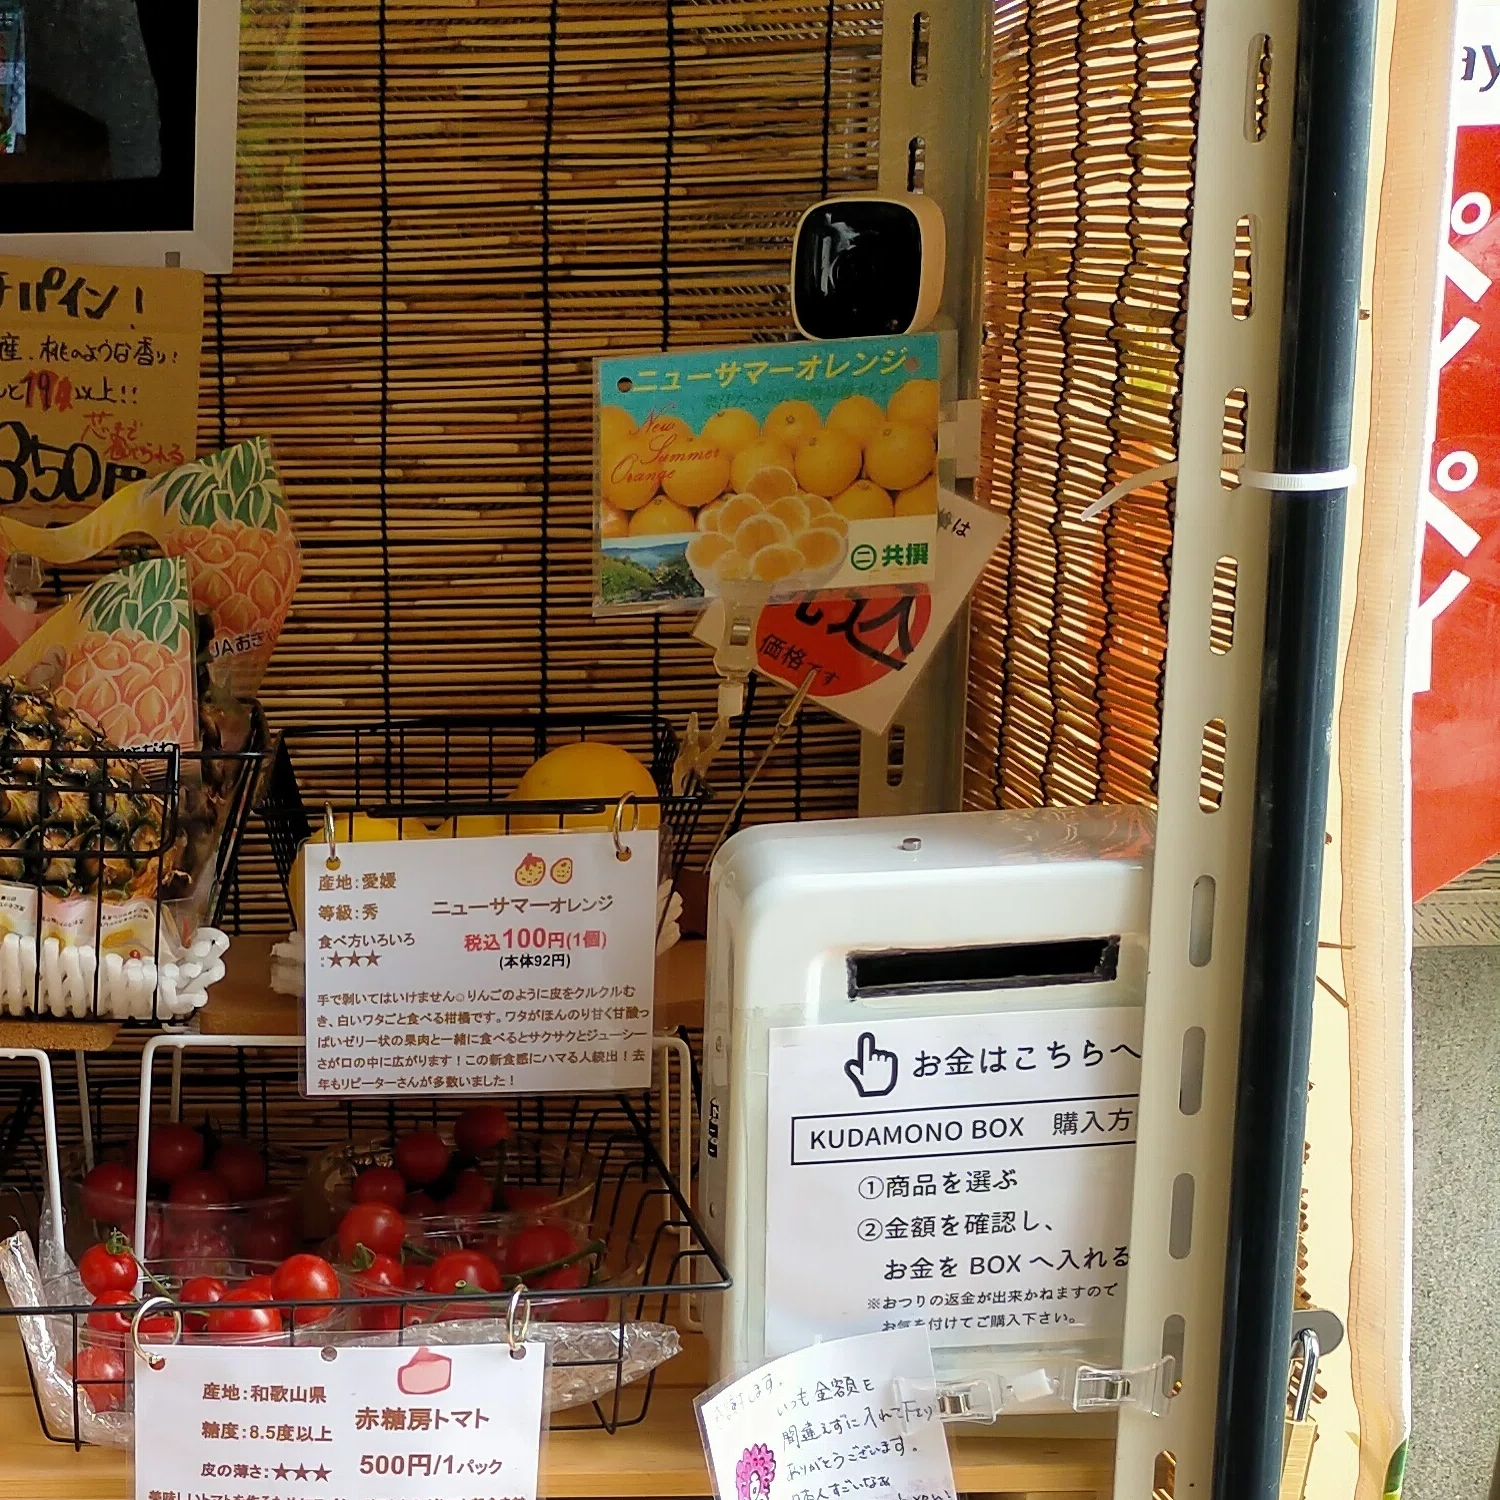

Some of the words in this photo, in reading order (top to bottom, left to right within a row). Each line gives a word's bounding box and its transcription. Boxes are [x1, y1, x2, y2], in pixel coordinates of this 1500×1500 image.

[633, 348, 907, 392] ニューサマーオレンジ
[630, 403, 675, 435] New
[641, 435, 721, 464] Summer
[611, 455, 674, 485] Orange
[318, 872, 397, 892] 産地:愛媛
[318, 904, 379, 922] 等級:秀
[432, 894, 613, 917] ニューサマーオレンジ
[318, 933, 416, 949] 食べ方いろいろ
[464, 927, 607, 952] 税込100円(1個)
[500, 954, 571, 970] (本体92円)
[911, 1038, 1142, 1078] お金はこちらへ
[810, 1120, 963, 1150] KUDAMONO
[972, 1117, 1025, 1139] BOX
[1051, 1107, 1134, 1137] 購入方
[858, 1168, 1018, 1200] ①商品を選ぶ
[857, 1210, 1056, 1242] ②金額を確認し、
[884, 1255, 958, 1281] お金を
[970, 1253, 1022, 1275] BOX
[1030, 1246, 1130, 1272] へ入れる
[203, 1382, 327, 1404] 産地:和歌山県
[355, 1407, 490, 1431] 赤糖房トマト
[201, 1421, 332, 1443] 糖度:8.5度以上
[360, 1454, 503, 1477] 500円/1パック
